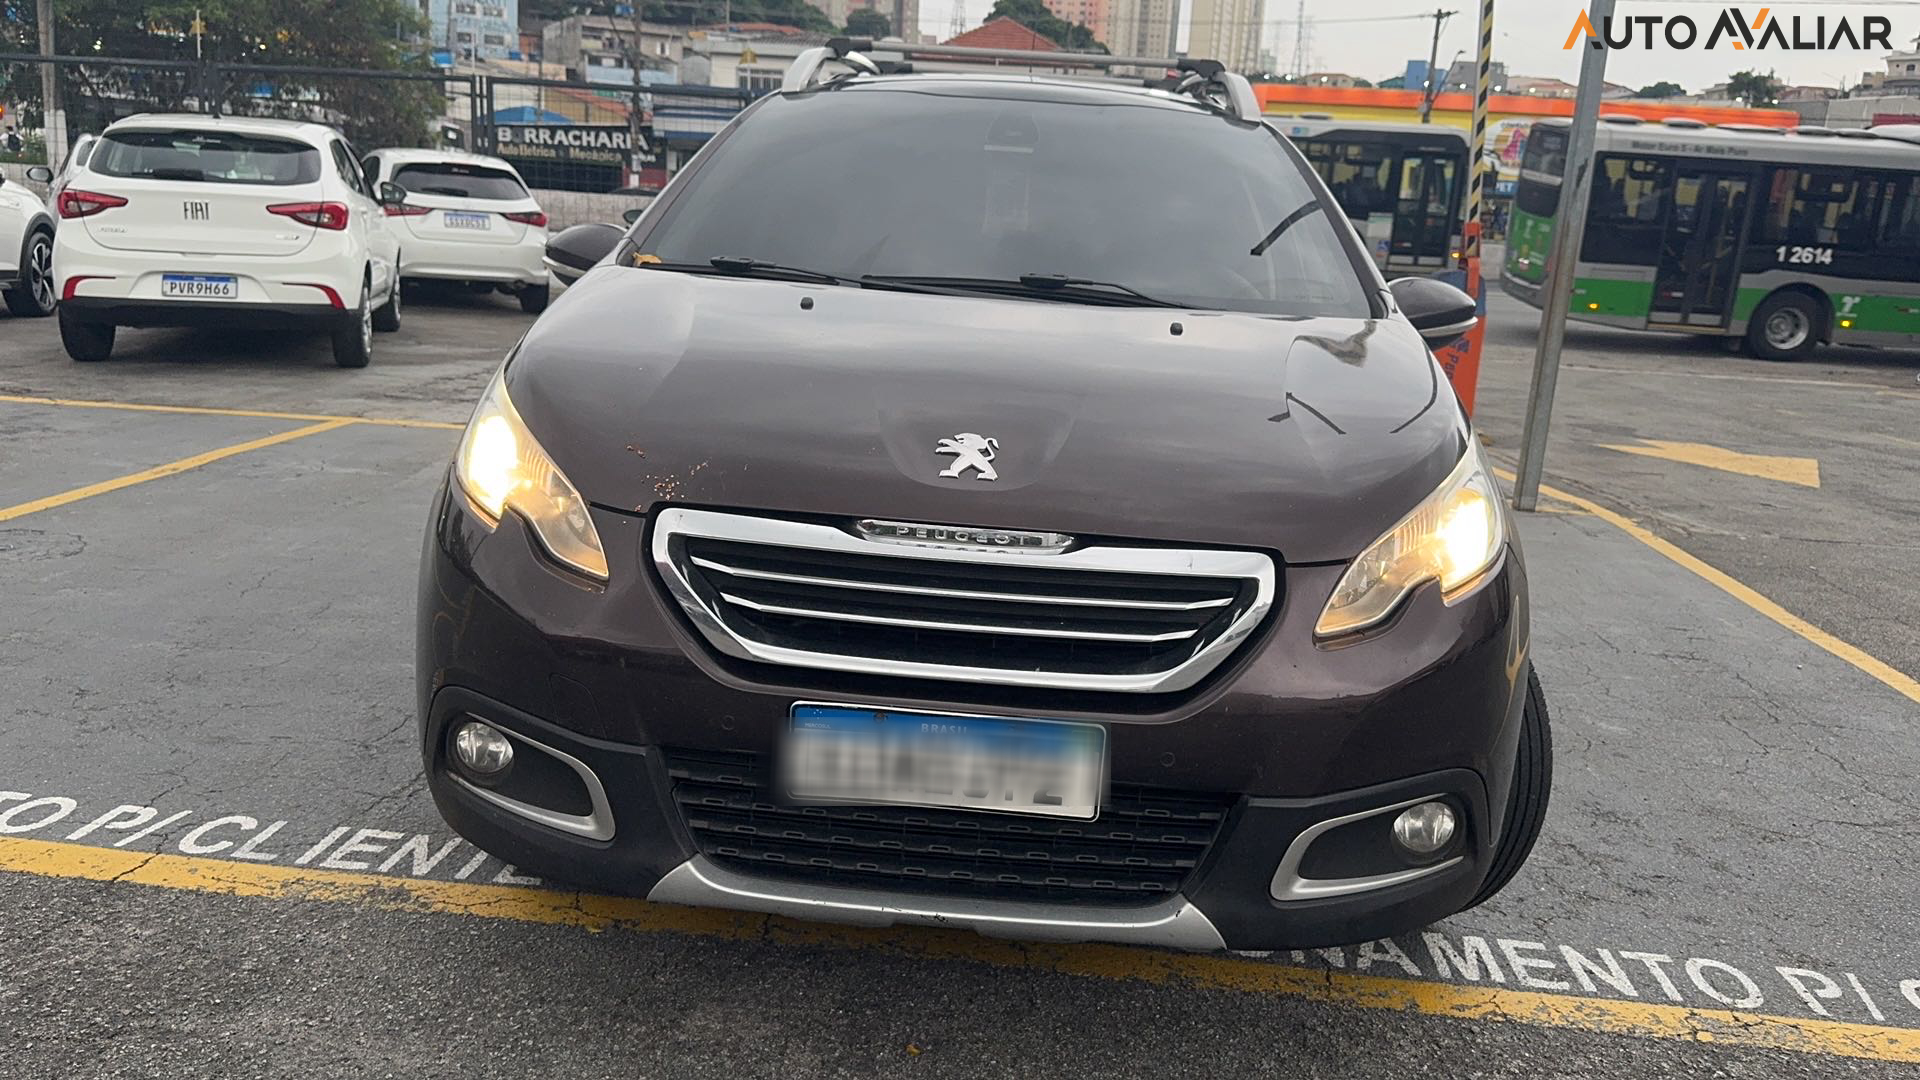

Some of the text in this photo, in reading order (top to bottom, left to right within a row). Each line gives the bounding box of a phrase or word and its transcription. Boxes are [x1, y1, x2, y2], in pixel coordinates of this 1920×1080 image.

[183, 201, 210, 220] FIAT
[169, 282, 230, 296] PVR9H66
[896, 525, 1030, 546] PEUGEOT
